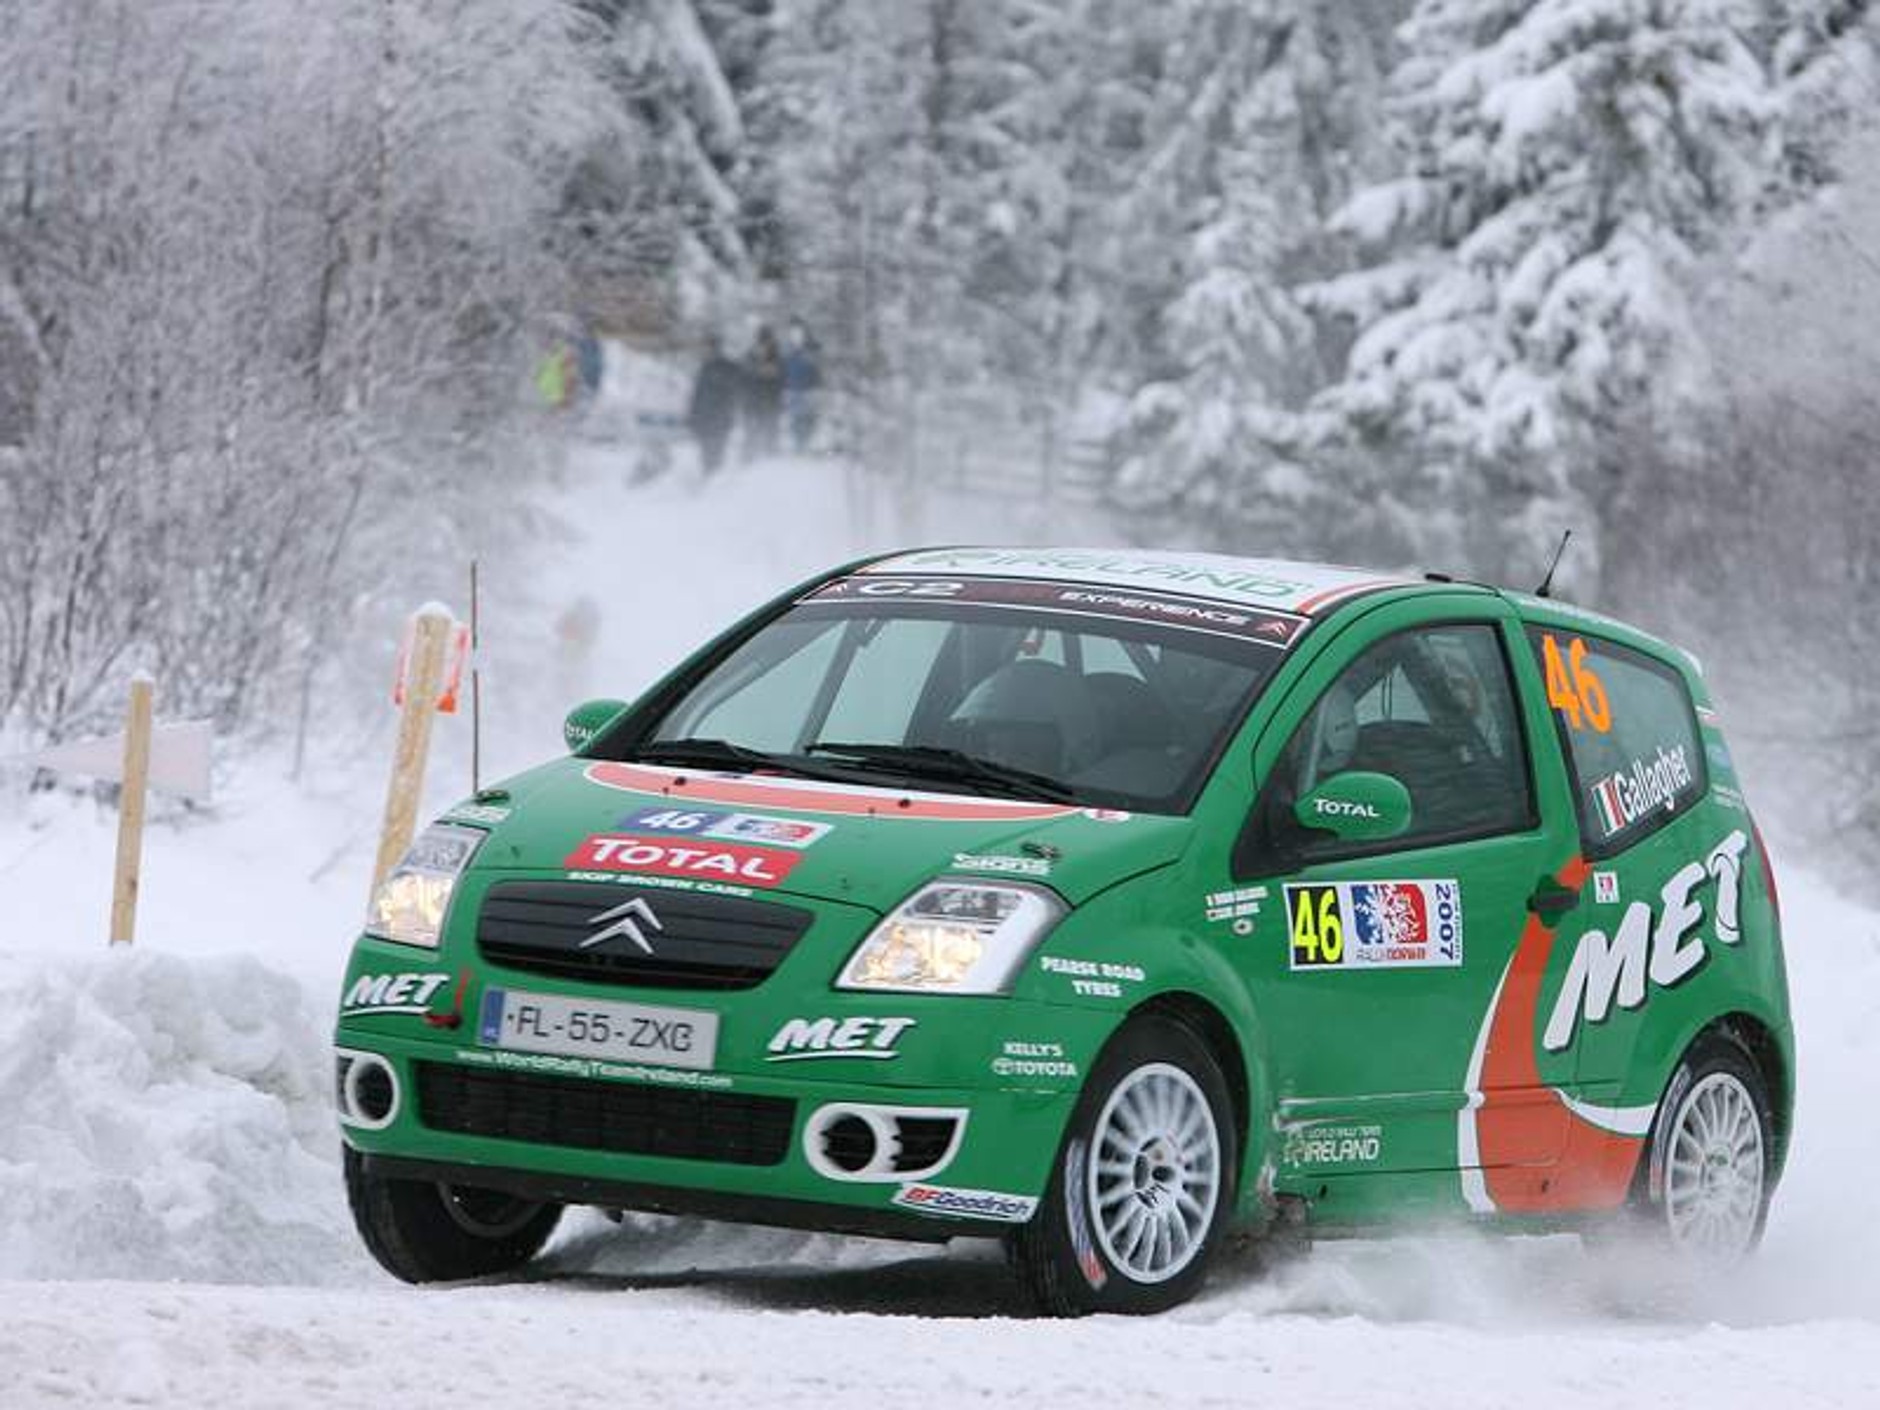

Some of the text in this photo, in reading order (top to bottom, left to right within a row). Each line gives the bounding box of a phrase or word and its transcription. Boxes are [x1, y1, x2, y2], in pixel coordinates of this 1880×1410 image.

[858, 581, 964, 597] C2
[1059, 590, 1251, 626] EXPERIENCE
[1542, 634, 1612, 733] 46
[1614, 744, 1692, 822] Gallagher
[639, 810, 706, 829] 46
[1314, 799, 1381, 818] TOTAL
[591, 838, 777, 881] TOTAL
[1294, 888, 1344, 963] 46
[1435, 883, 1454, 961] 2007
[1543, 829, 1748, 1050] MET
[342, 972, 451, 1006] MET
[1072, 979, 1123, 998] TYRES
[766, 1015, 918, 1052] MET
[1014, 1059, 1078, 1076] TOYOTA
[1303, 1138, 1380, 1163] IRELAND
[904, 1186, 1030, 1215] BFGoodrich
